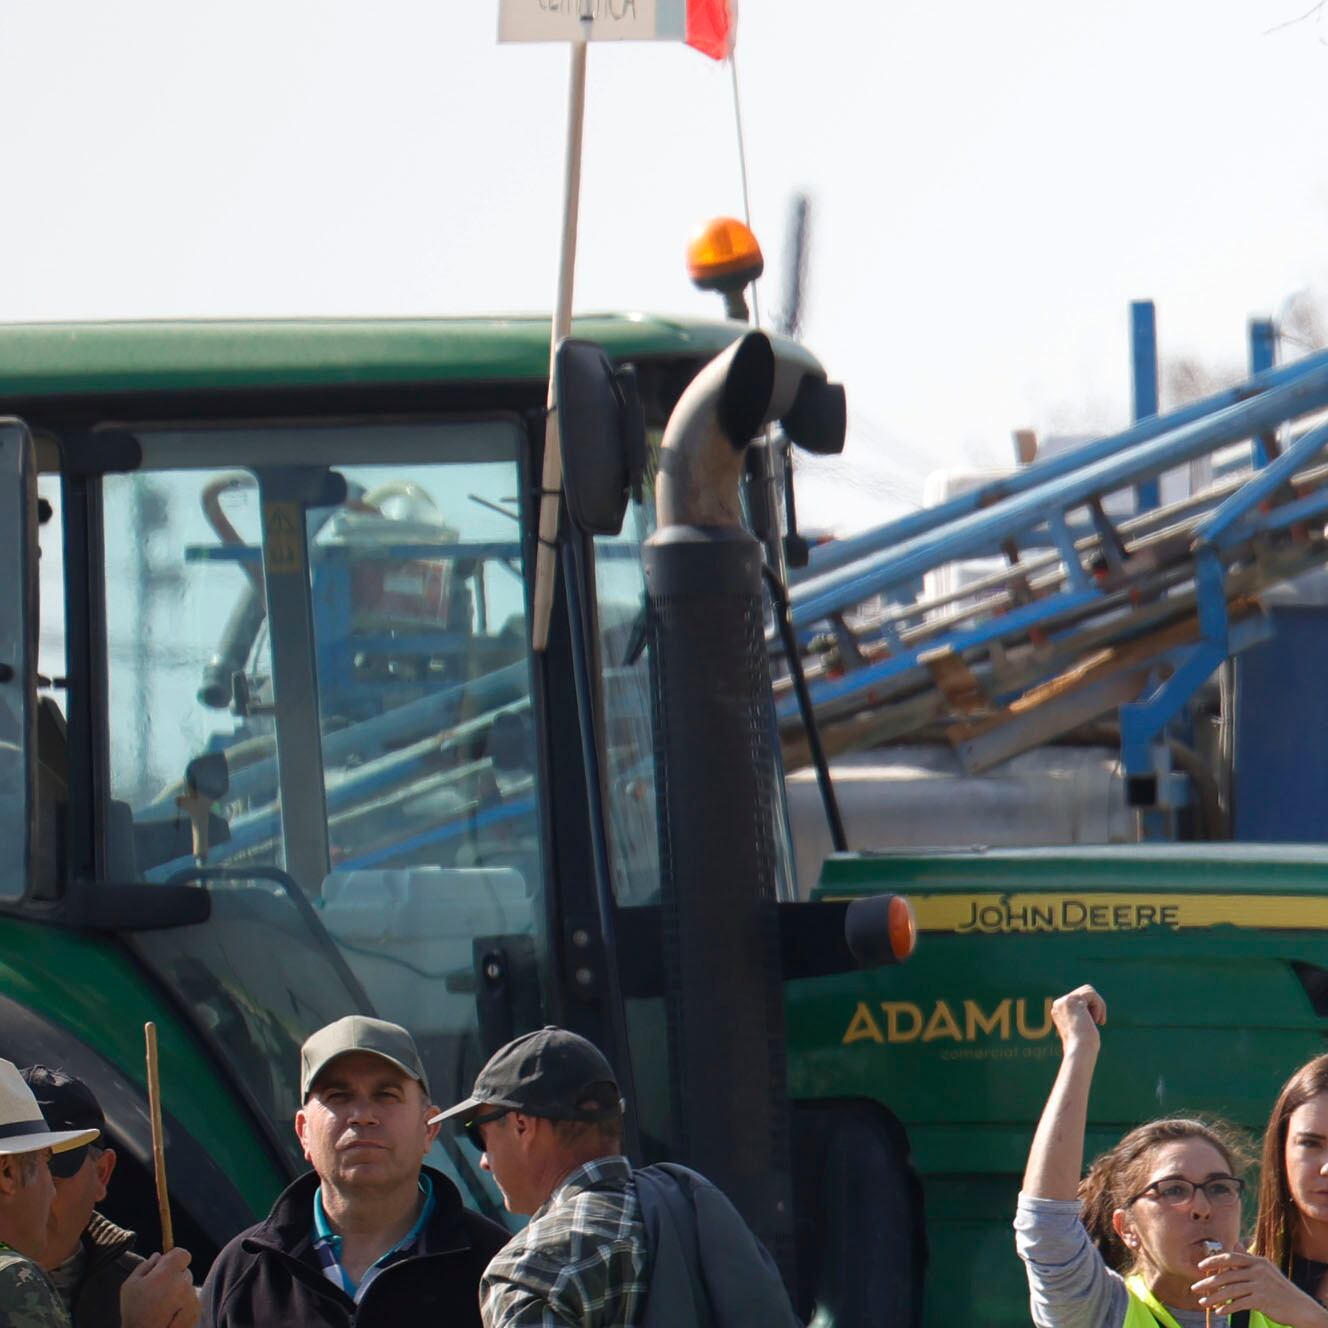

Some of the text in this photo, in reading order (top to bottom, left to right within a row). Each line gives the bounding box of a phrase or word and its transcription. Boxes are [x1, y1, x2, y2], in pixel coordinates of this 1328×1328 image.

[959, 899, 1180, 930] JOHN DEERE
[842, 997, 1057, 1045] ADAMU
